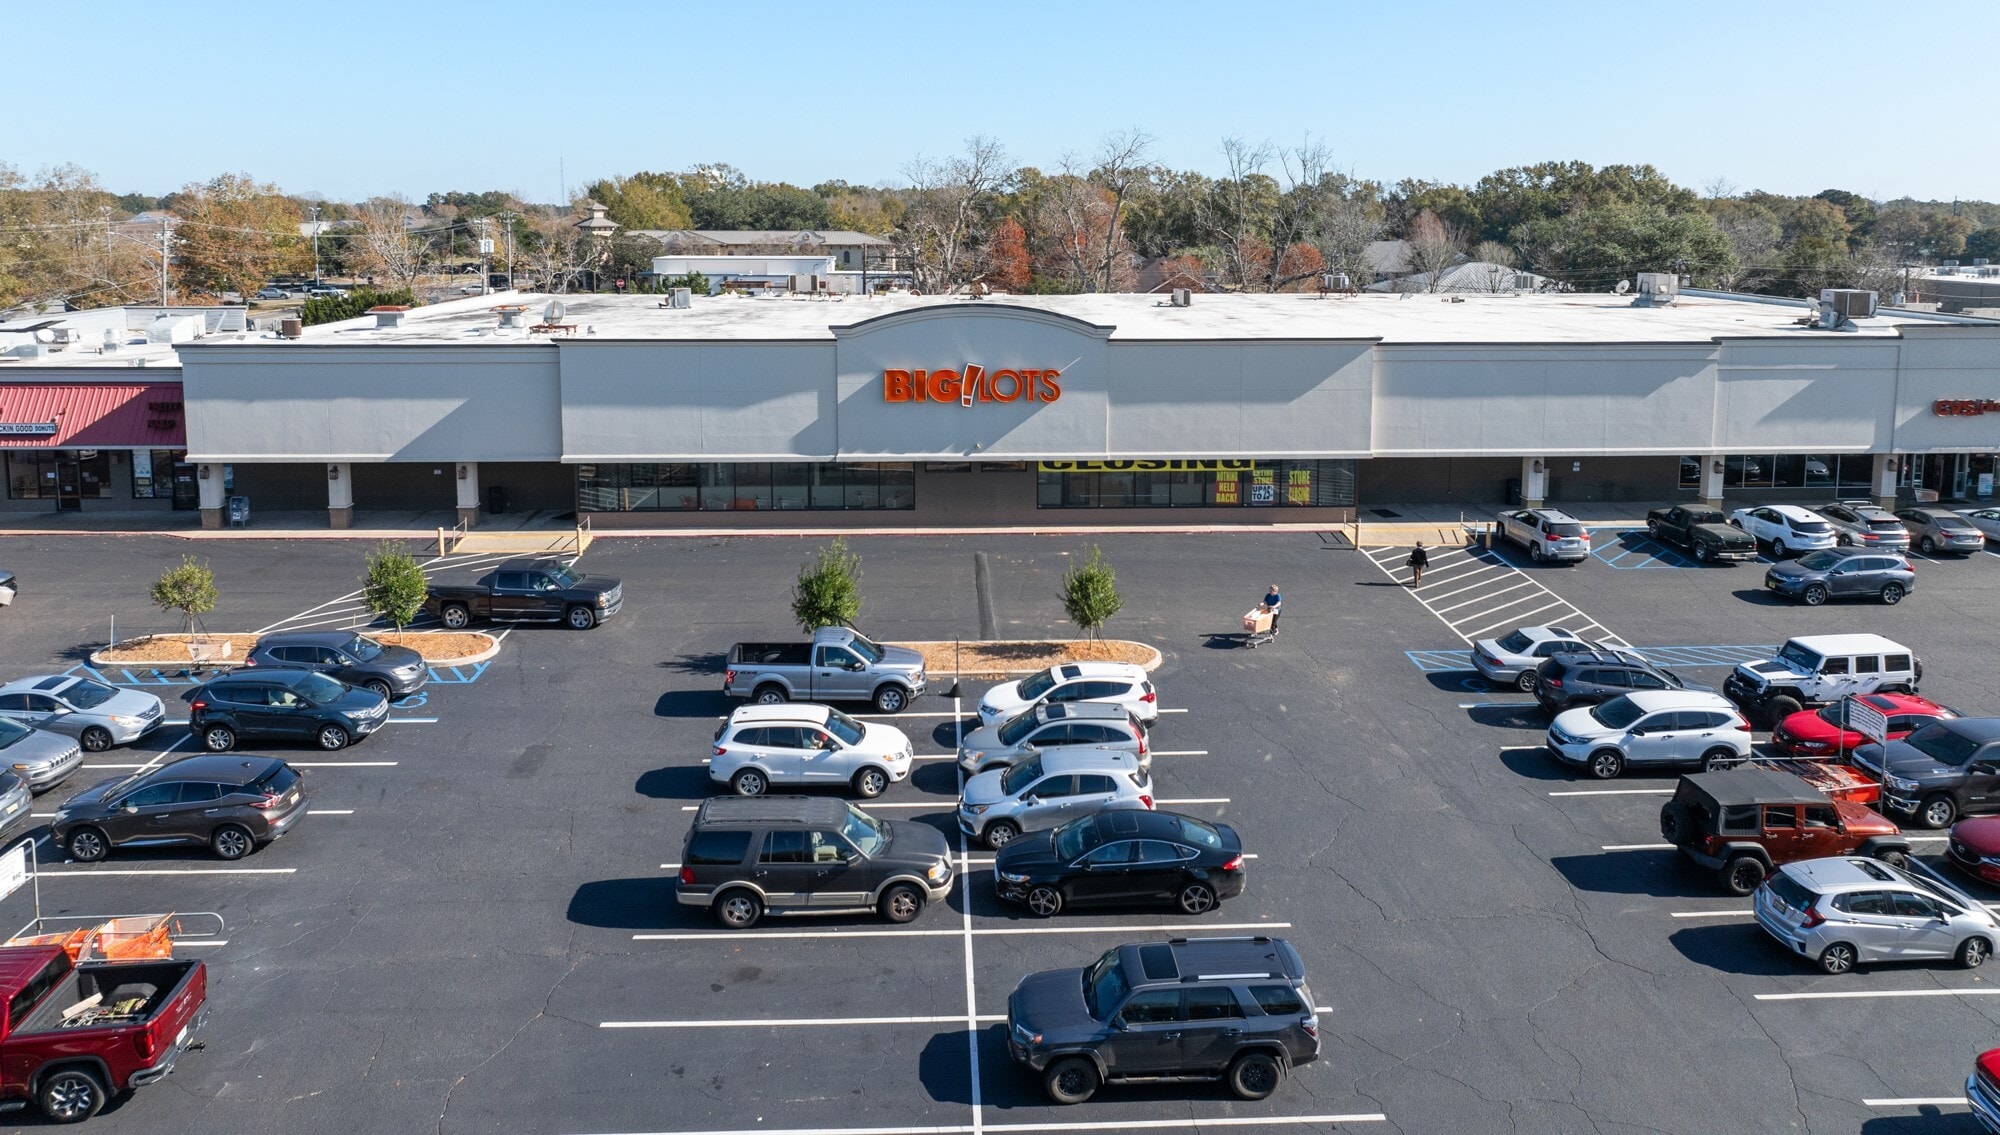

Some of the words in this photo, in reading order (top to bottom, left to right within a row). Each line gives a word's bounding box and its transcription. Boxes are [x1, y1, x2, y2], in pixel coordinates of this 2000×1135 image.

[1253, 476, 1274, 484] STORE
[1289, 470, 1310, 484] STORE
[1219, 482, 1235, 492] HELD
[1216, 493, 1238, 503] BACK!
[1288, 487, 1310, 502] CLOSING
